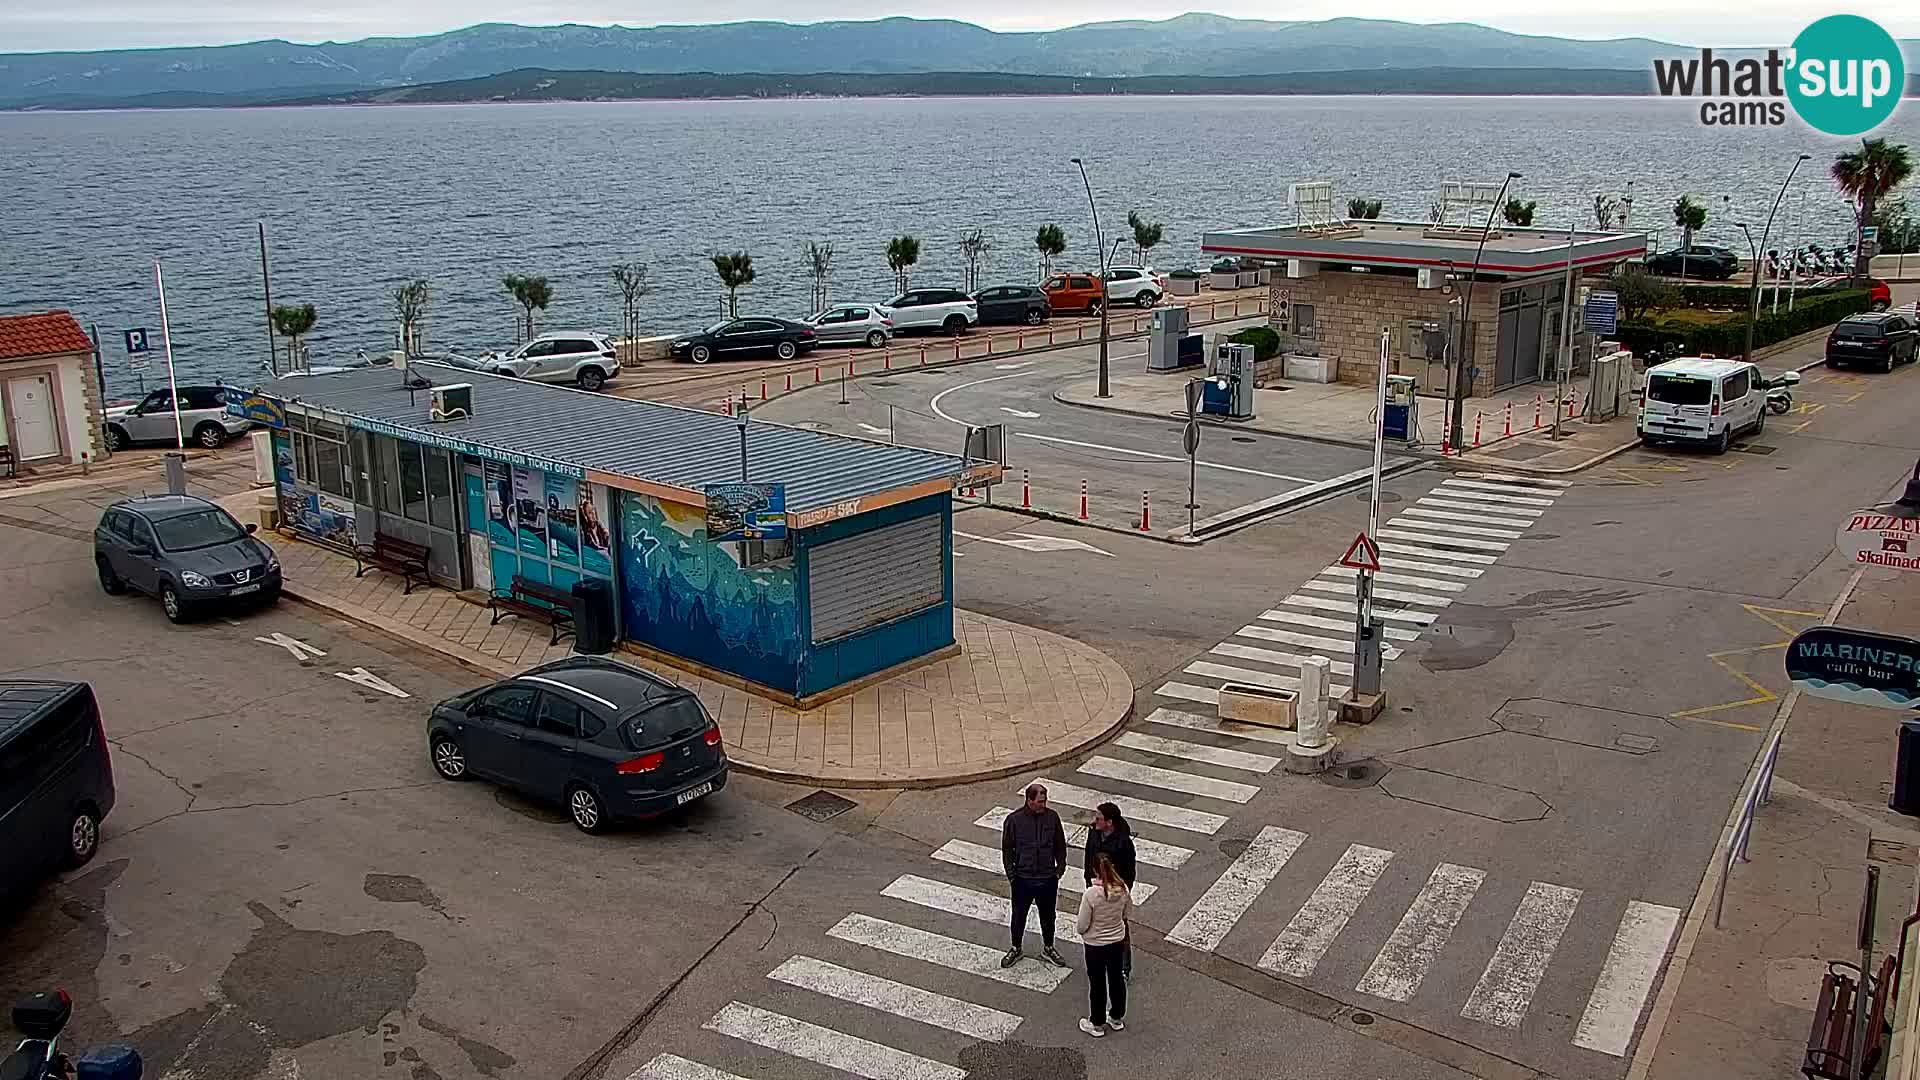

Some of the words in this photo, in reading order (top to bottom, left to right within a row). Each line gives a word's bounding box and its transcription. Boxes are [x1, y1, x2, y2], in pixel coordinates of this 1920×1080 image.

[129, 331, 142, 350] P
[493, 449, 525, 465] STATION
[527, 457, 553, 471] TICKET
[555, 463, 581, 477] OFFICE
[1868, 666, 1894, 681] bar
